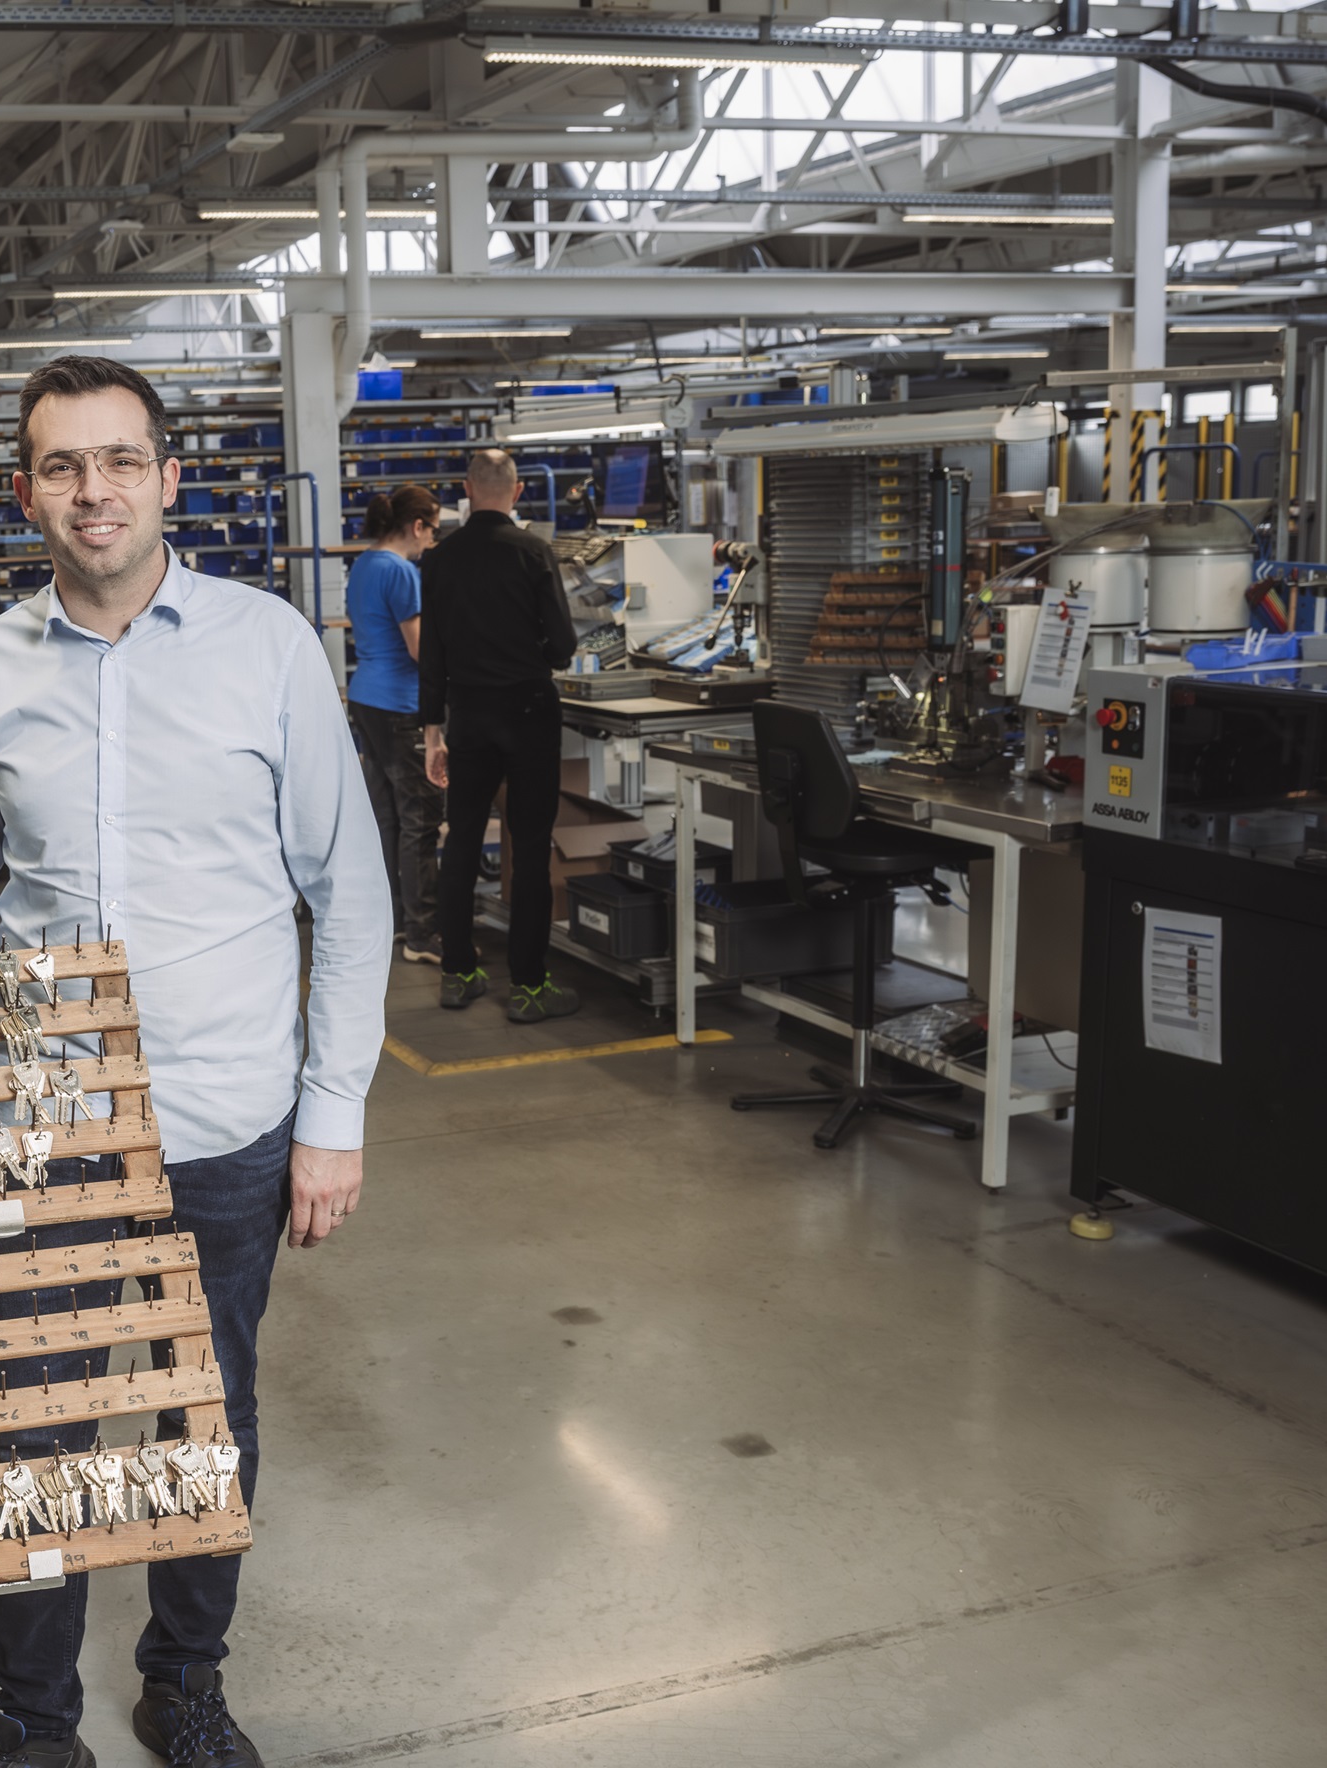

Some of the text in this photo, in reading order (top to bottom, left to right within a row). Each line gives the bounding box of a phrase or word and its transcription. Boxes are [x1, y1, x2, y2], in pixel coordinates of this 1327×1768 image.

[1092, 802, 1150, 824] ASSA ABLOY
[0, 1409, 20, 1422] 56
[45, 1404, 67, 1416] 57
[88, 1400, 110, 1413] 58
[127, 1394, 148, 1405] 59
[169, 1388, 187, 1398] 60
[203, 1383, 223, 1395] 61
[64, 1553, 86, 1566] 99
[146, 1539, 174, 1551] 101
